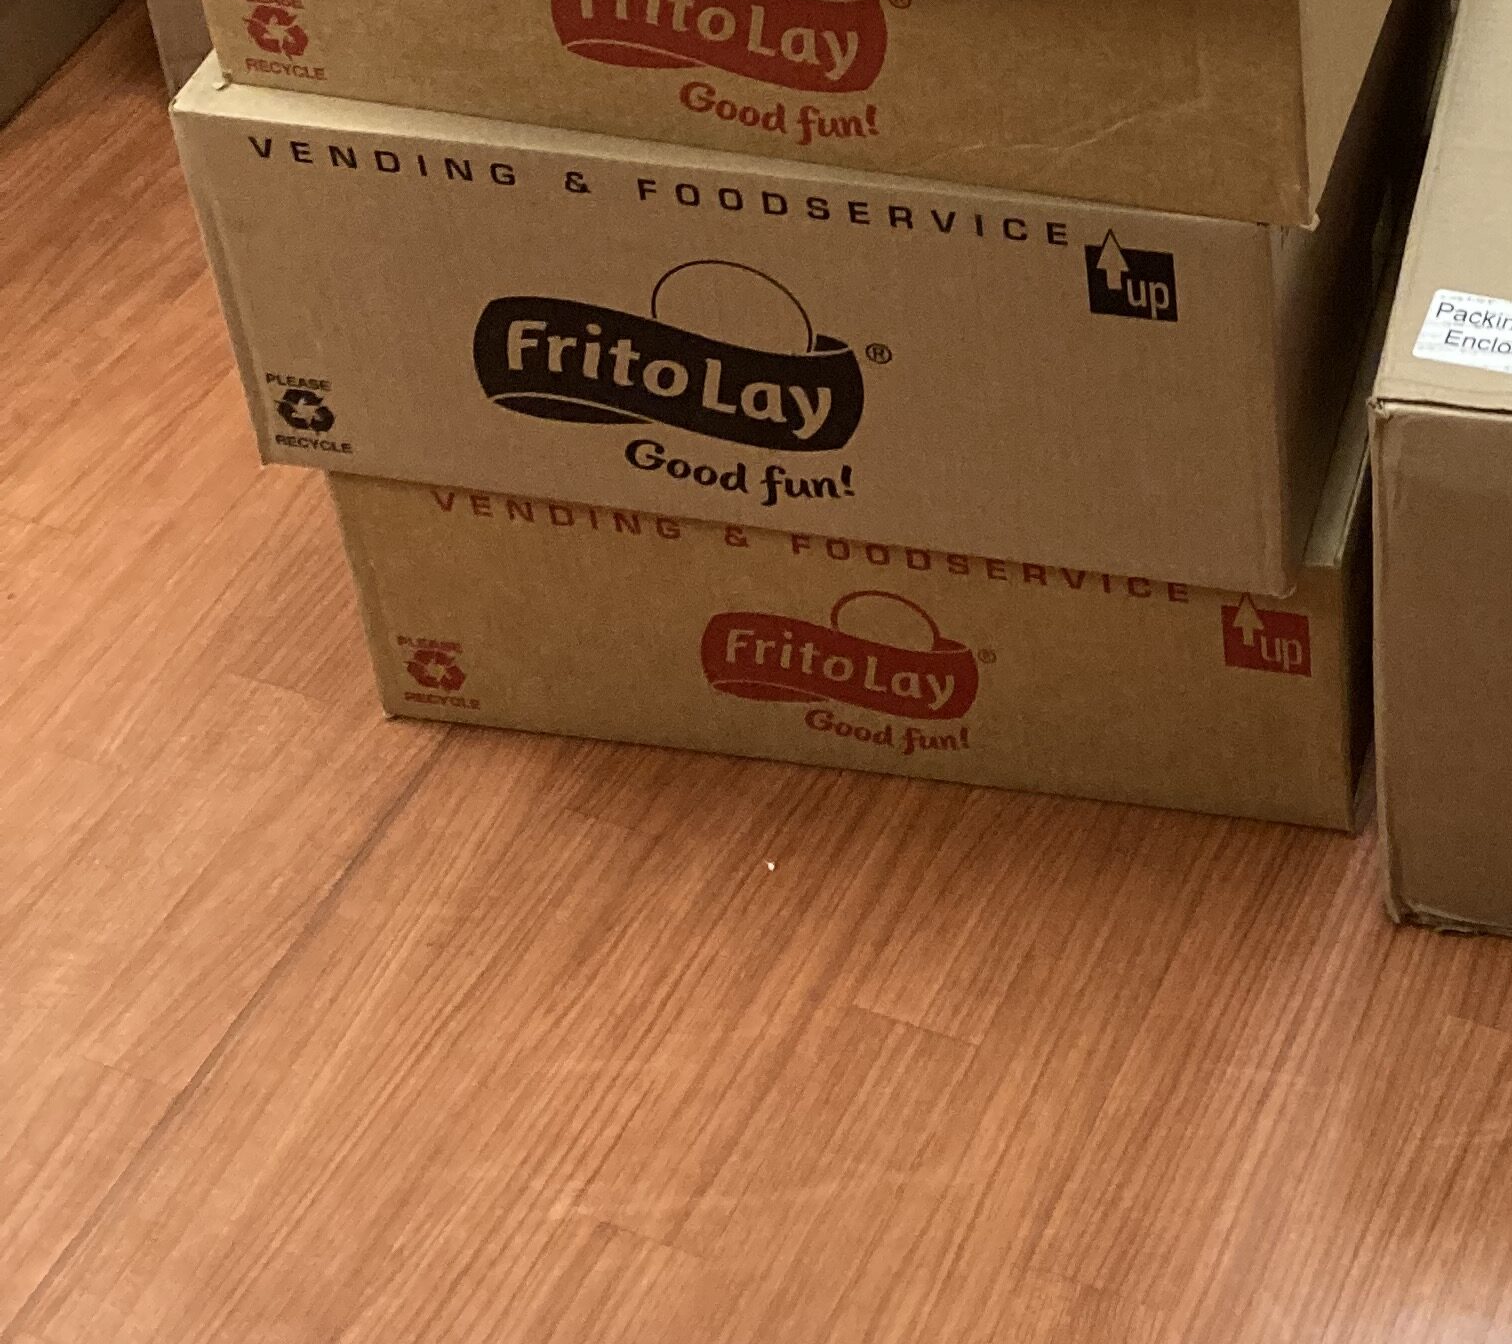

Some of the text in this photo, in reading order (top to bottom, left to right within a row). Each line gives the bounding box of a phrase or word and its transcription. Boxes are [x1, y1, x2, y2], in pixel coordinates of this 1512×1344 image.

[245, 57, 327, 82] RECYCLE
[679, 81, 880, 143] Good fun!
[249, 135, 1071, 246] VENDING & FOODSERVICE
[1126, 277, 1171, 313] up
[265, 372, 332, 392] PLEASE
[275, 434, 353, 455] RECYCLE
[625, 437, 854, 506] Good fun!
[432, 490, 1190, 603] VENDING FOODSERVICE
[804, 709, 970, 755] Good fun!
